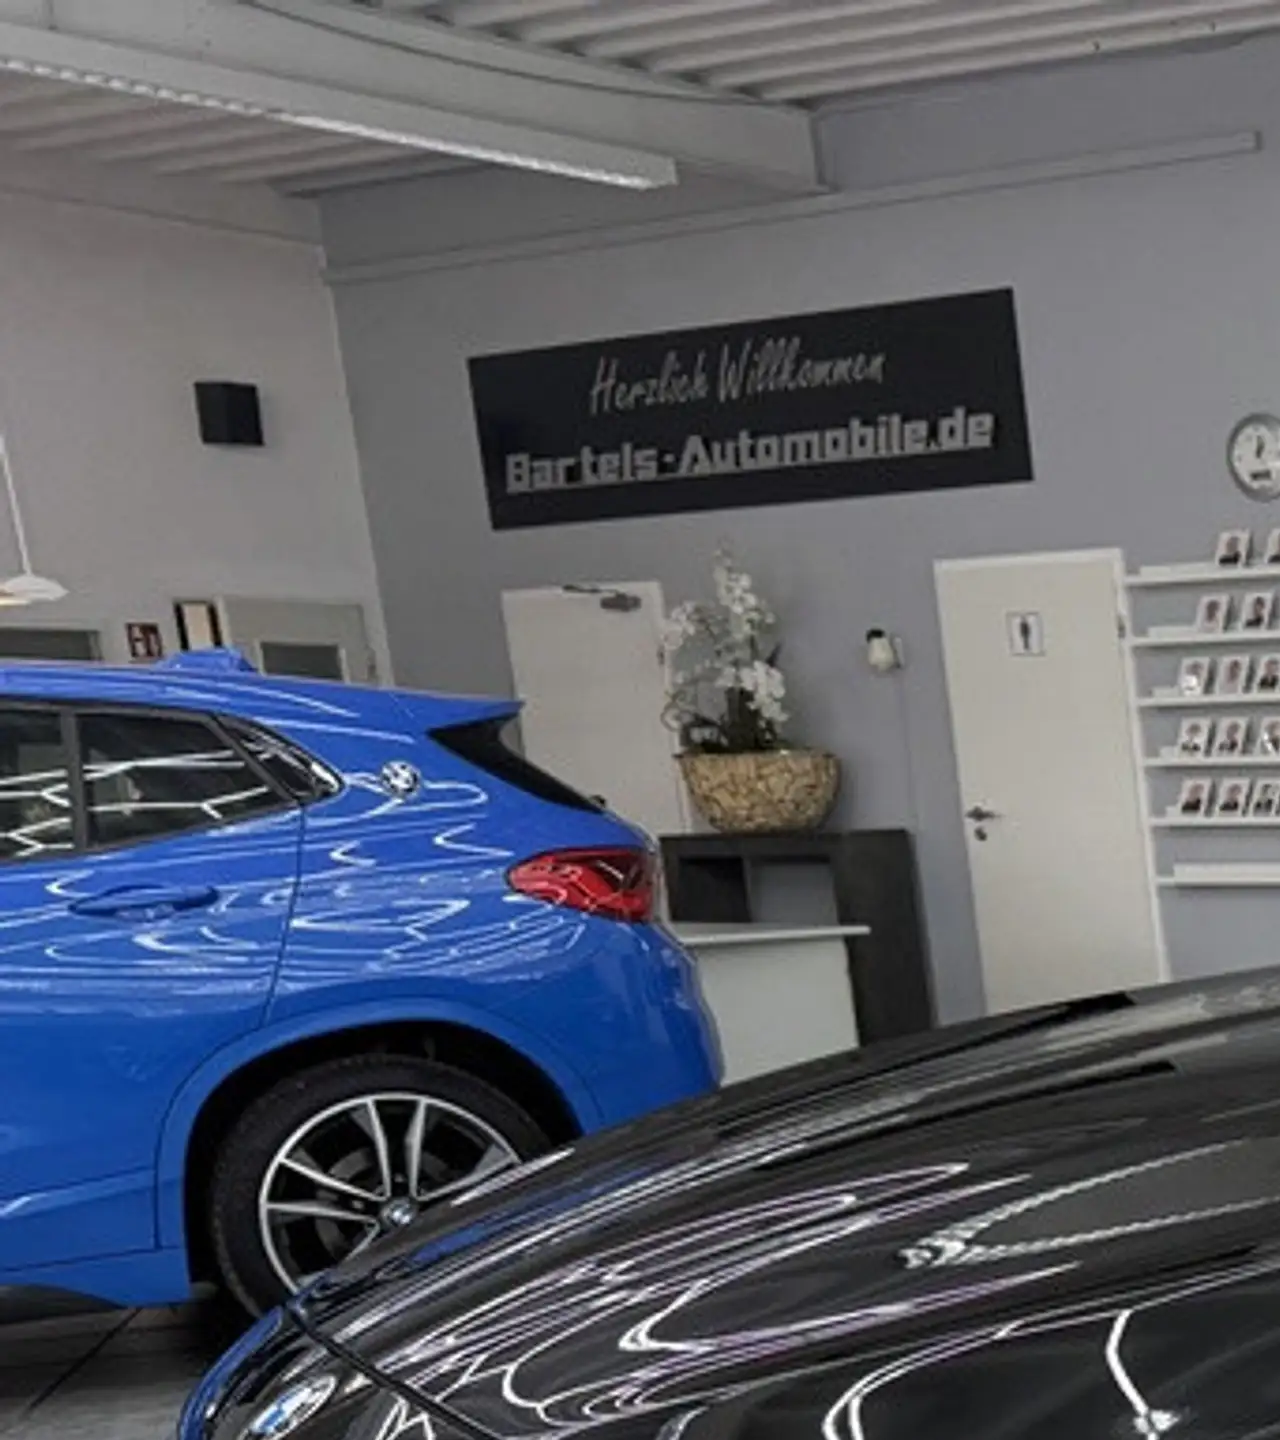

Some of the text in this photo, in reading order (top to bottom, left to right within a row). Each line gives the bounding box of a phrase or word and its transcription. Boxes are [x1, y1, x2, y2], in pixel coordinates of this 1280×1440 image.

[590, 336, 887, 416] Herzlich Willkommen
[505, 406, 996, 494] Bartels-Automobile.de
